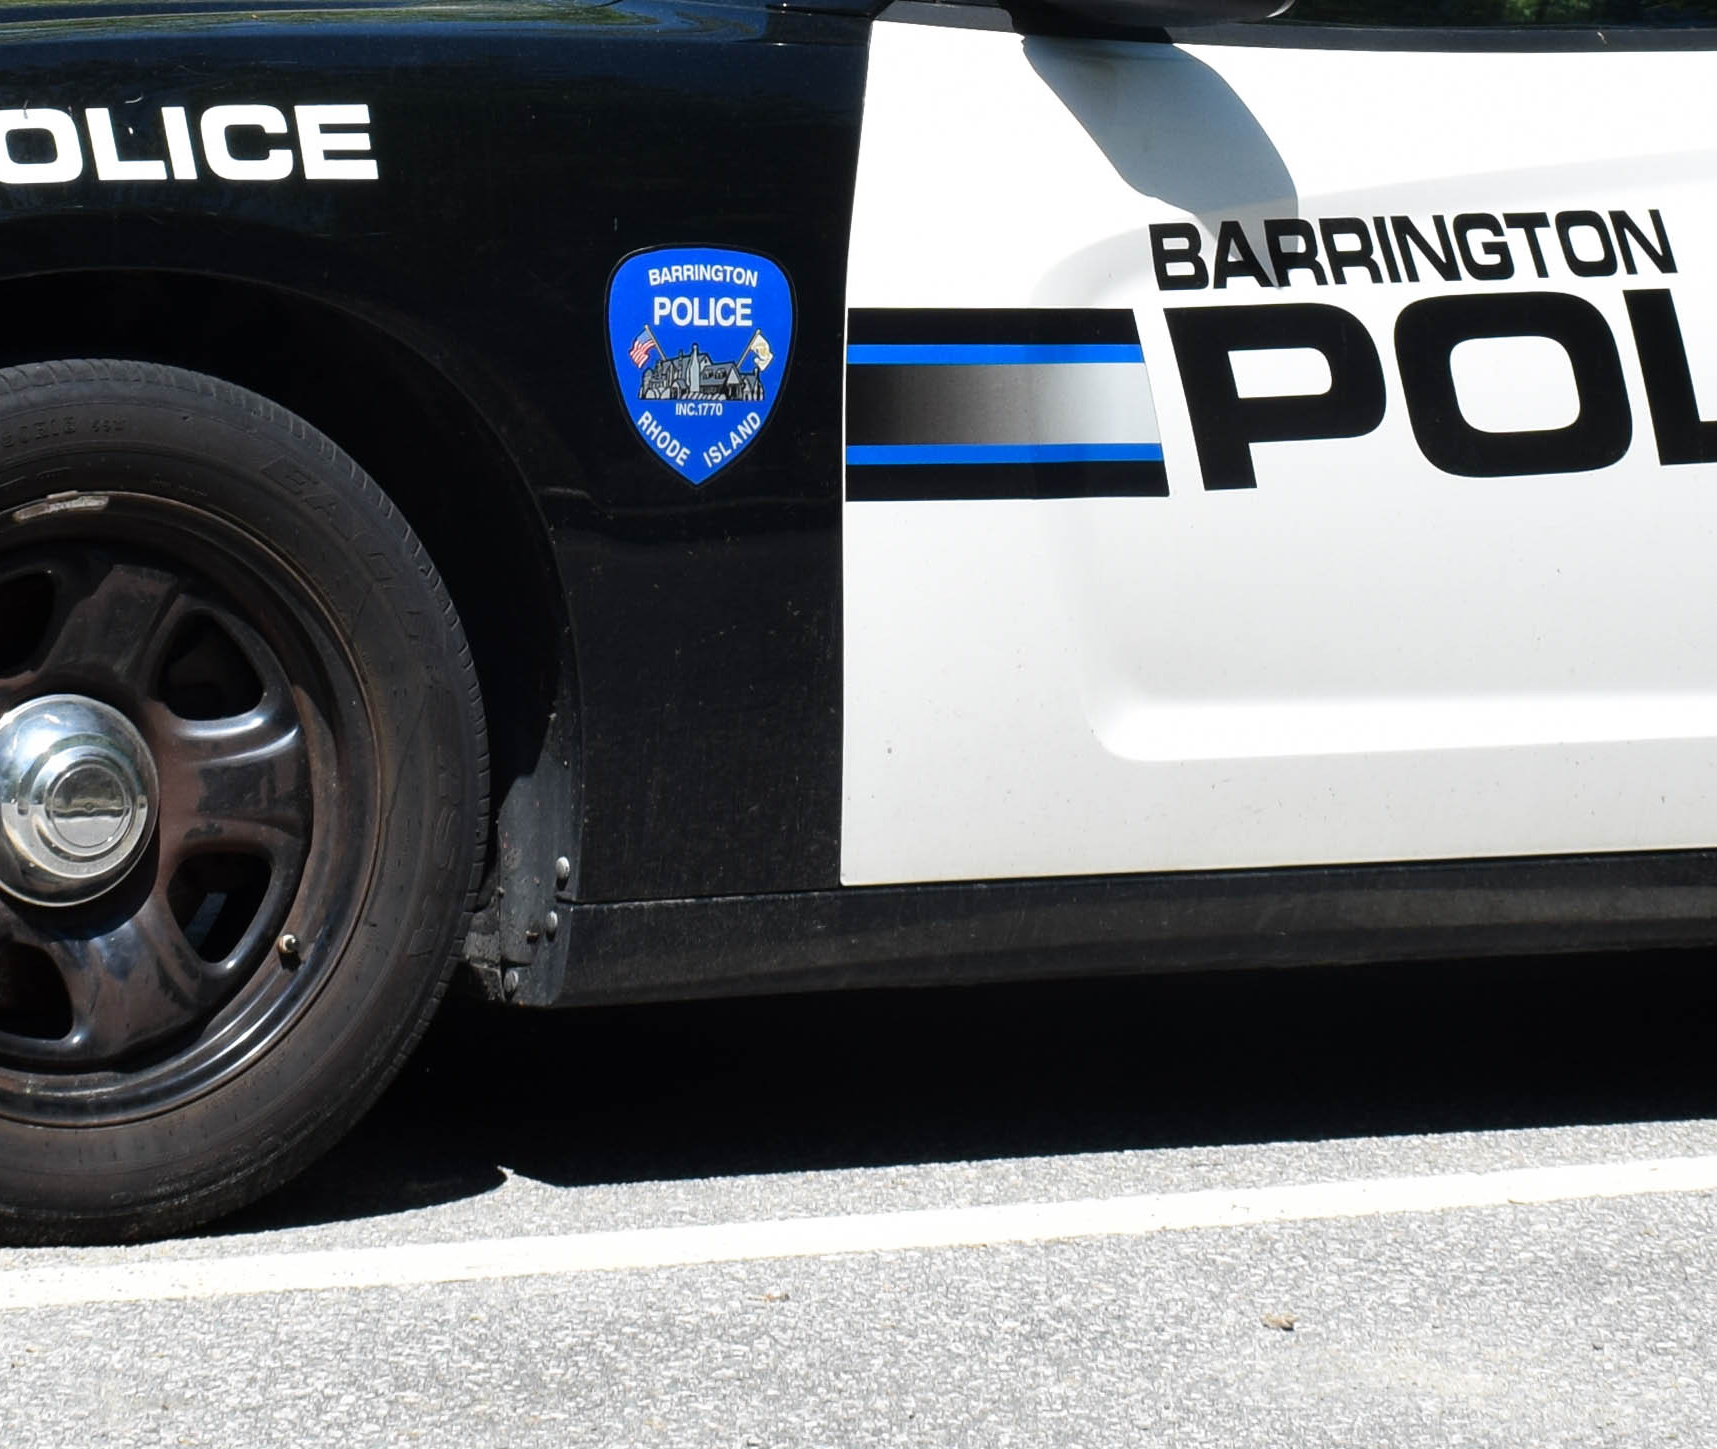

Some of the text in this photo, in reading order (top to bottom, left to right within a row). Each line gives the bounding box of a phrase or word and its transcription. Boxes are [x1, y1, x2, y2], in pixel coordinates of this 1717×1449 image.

[1149, 208, 1677, 291] BARRINGTON
[648, 264, 758, 288] BARRINGTON
[653, 296, 753, 327] POLICE
[675, 402, 723, 416] INC.1770
[637, 410, 691, 466] RHODE
[702, 411, 761, 468] ISLAND
